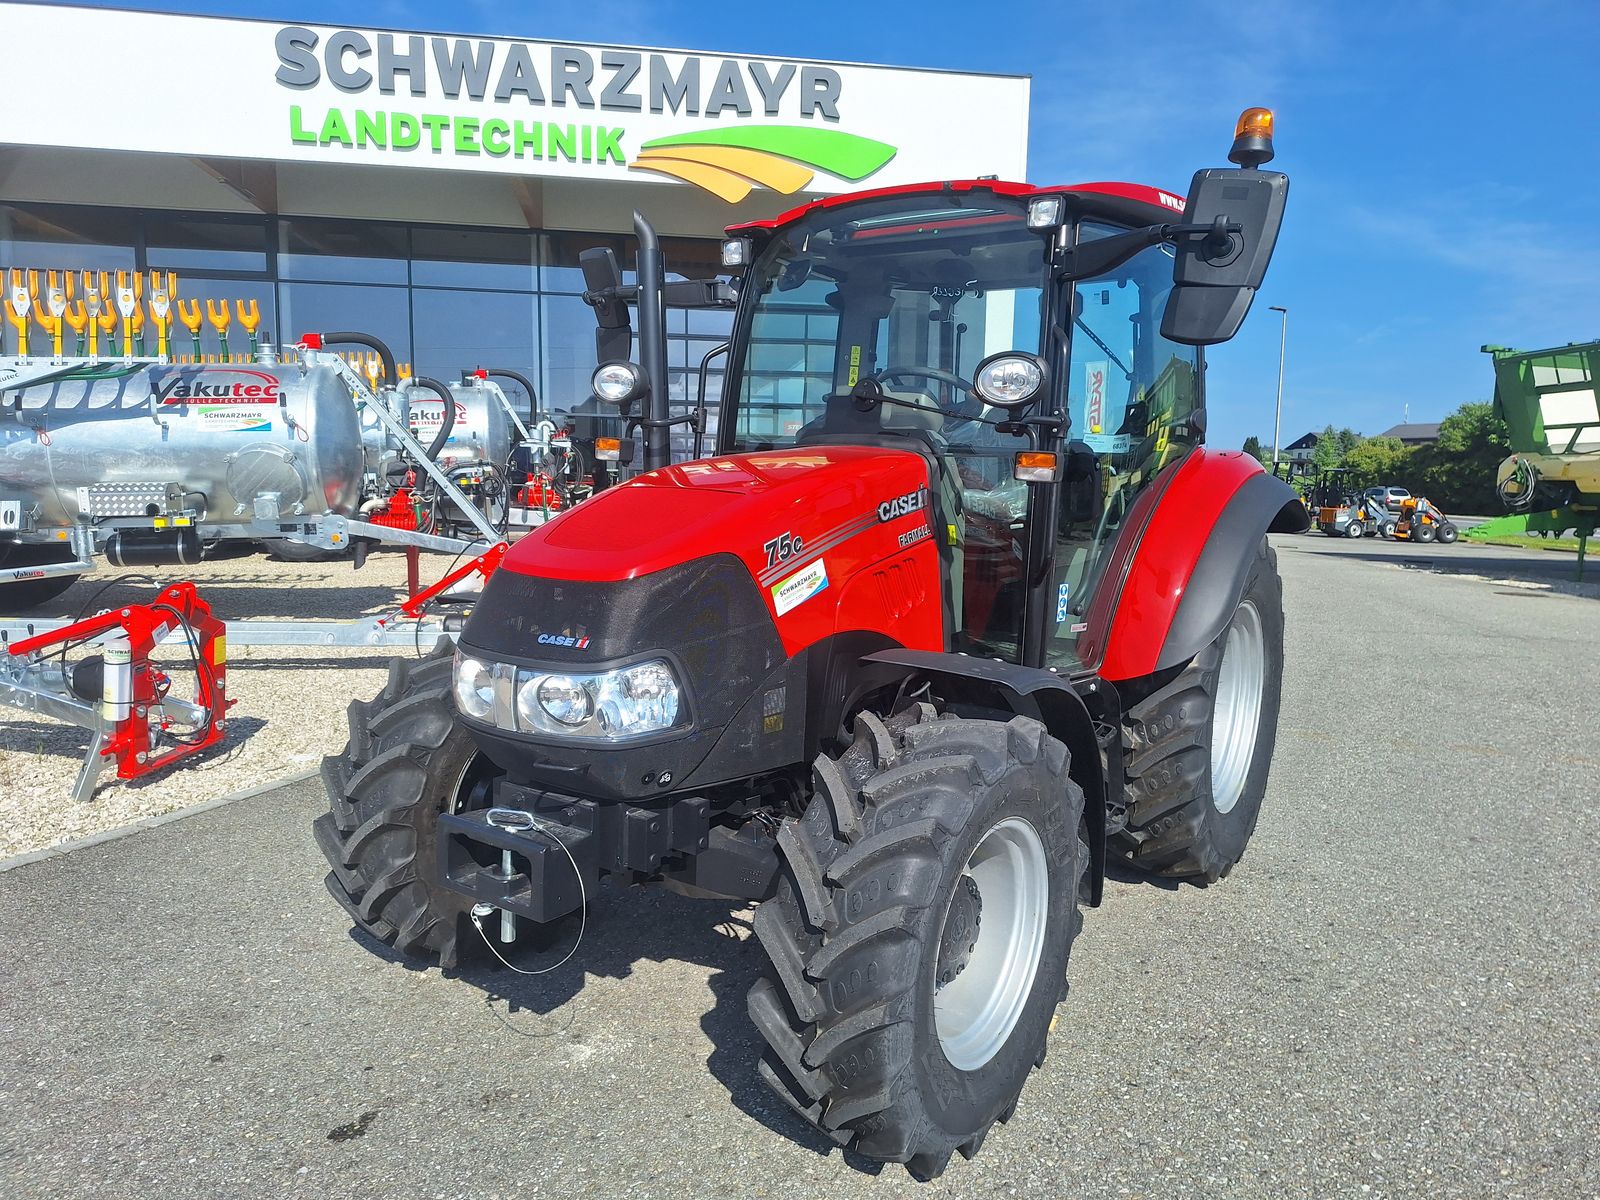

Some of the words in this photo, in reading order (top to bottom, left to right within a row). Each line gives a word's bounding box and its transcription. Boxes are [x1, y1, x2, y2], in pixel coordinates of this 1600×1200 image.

[274, 26, 842, 122] SCHWARZMAYR
[289, 104, 626, 165] LANDTECHNIK
[150, 377, 279, 405] Vakutec
[879, 492, 916, 521] CASE
[898, 524, 931, 547] FARMALL
[13, 570, 45, 579] Vakutec
[779, 571, 817, 598] SCHWARZMAYR
[537, 633, 576, 647] CASE
